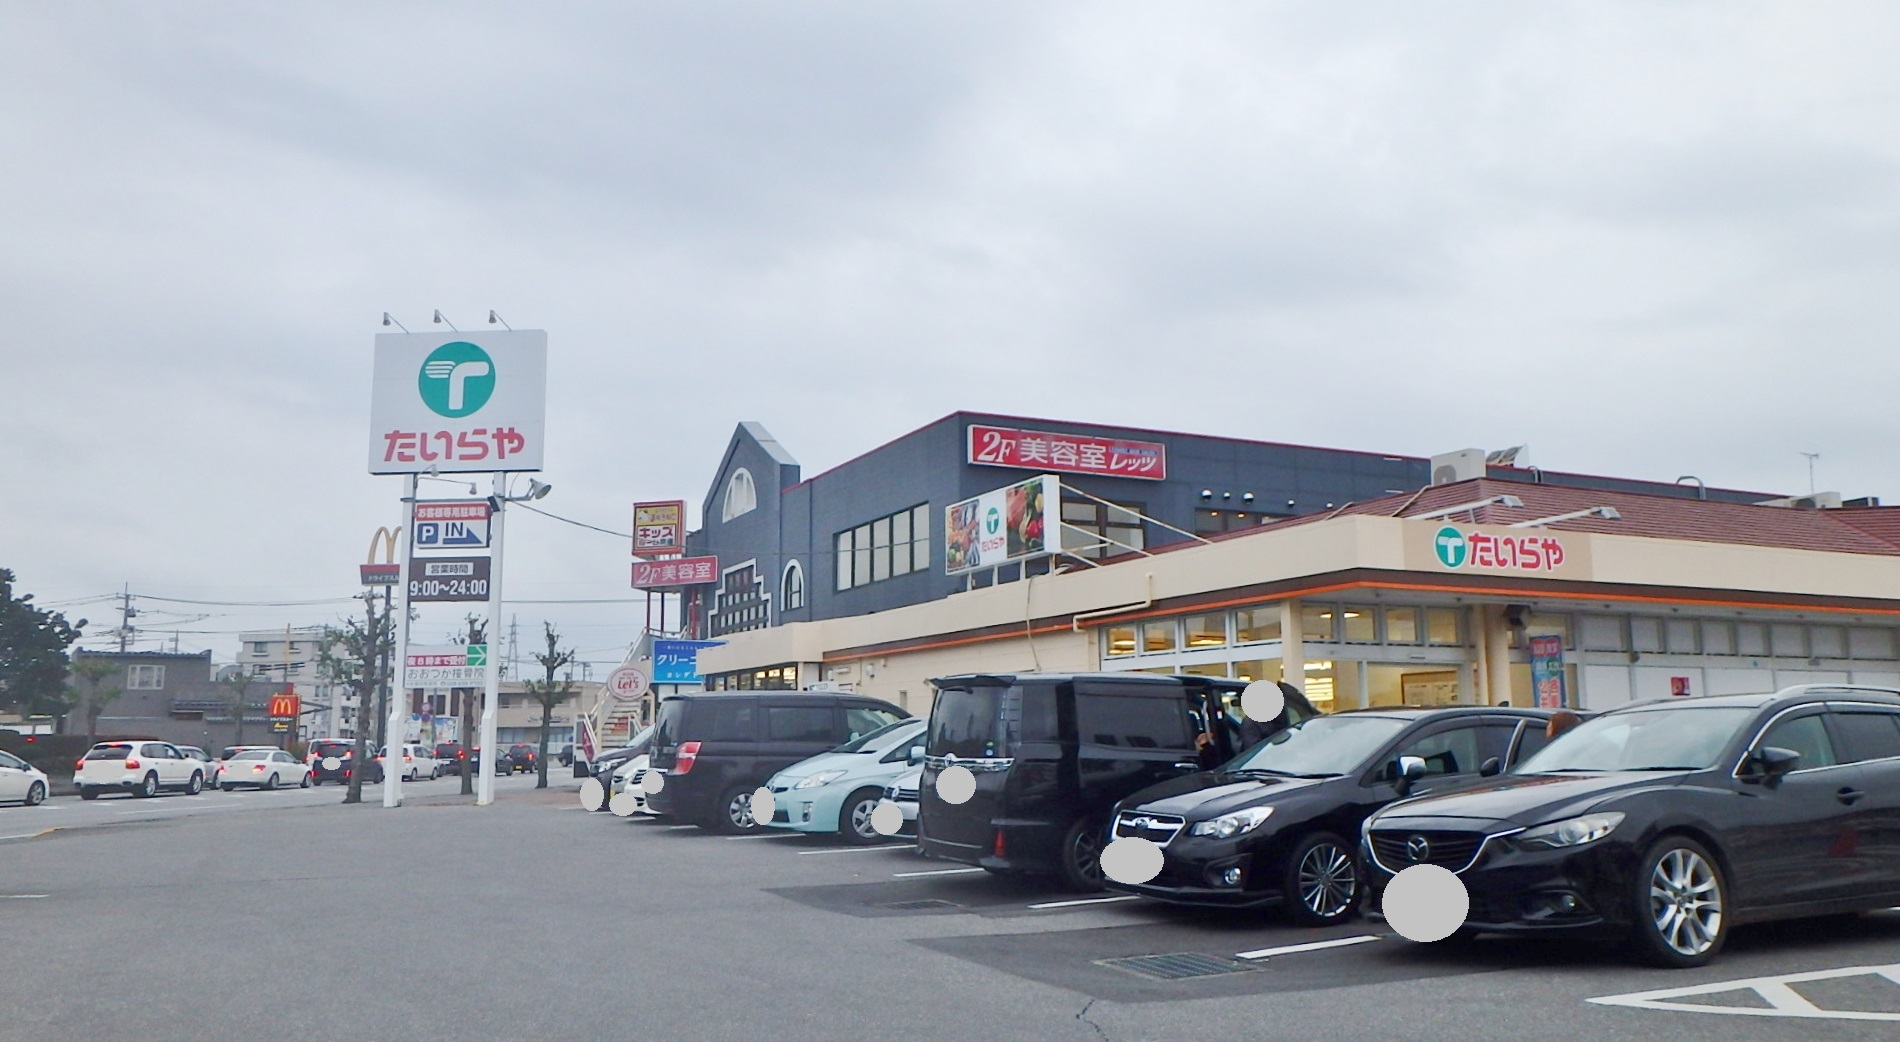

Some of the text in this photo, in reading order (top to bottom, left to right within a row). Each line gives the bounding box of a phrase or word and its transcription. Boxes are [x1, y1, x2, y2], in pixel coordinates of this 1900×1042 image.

[384, 427, 525, 462] たいらや
[1110, 453, 1157, 472] レッツ
[417, 506, 486, 518] お客様専用駐車場
[445, 522, 464, 537] IN
[639, 525, 673, 538] キッズ
[1467, 532, 1566, 570] たいらや
[431, 564, 469, 574] 営業時間
[408, 667, 485, 680] おおつか接骨院
[617, 679, 639, 689] Let's
